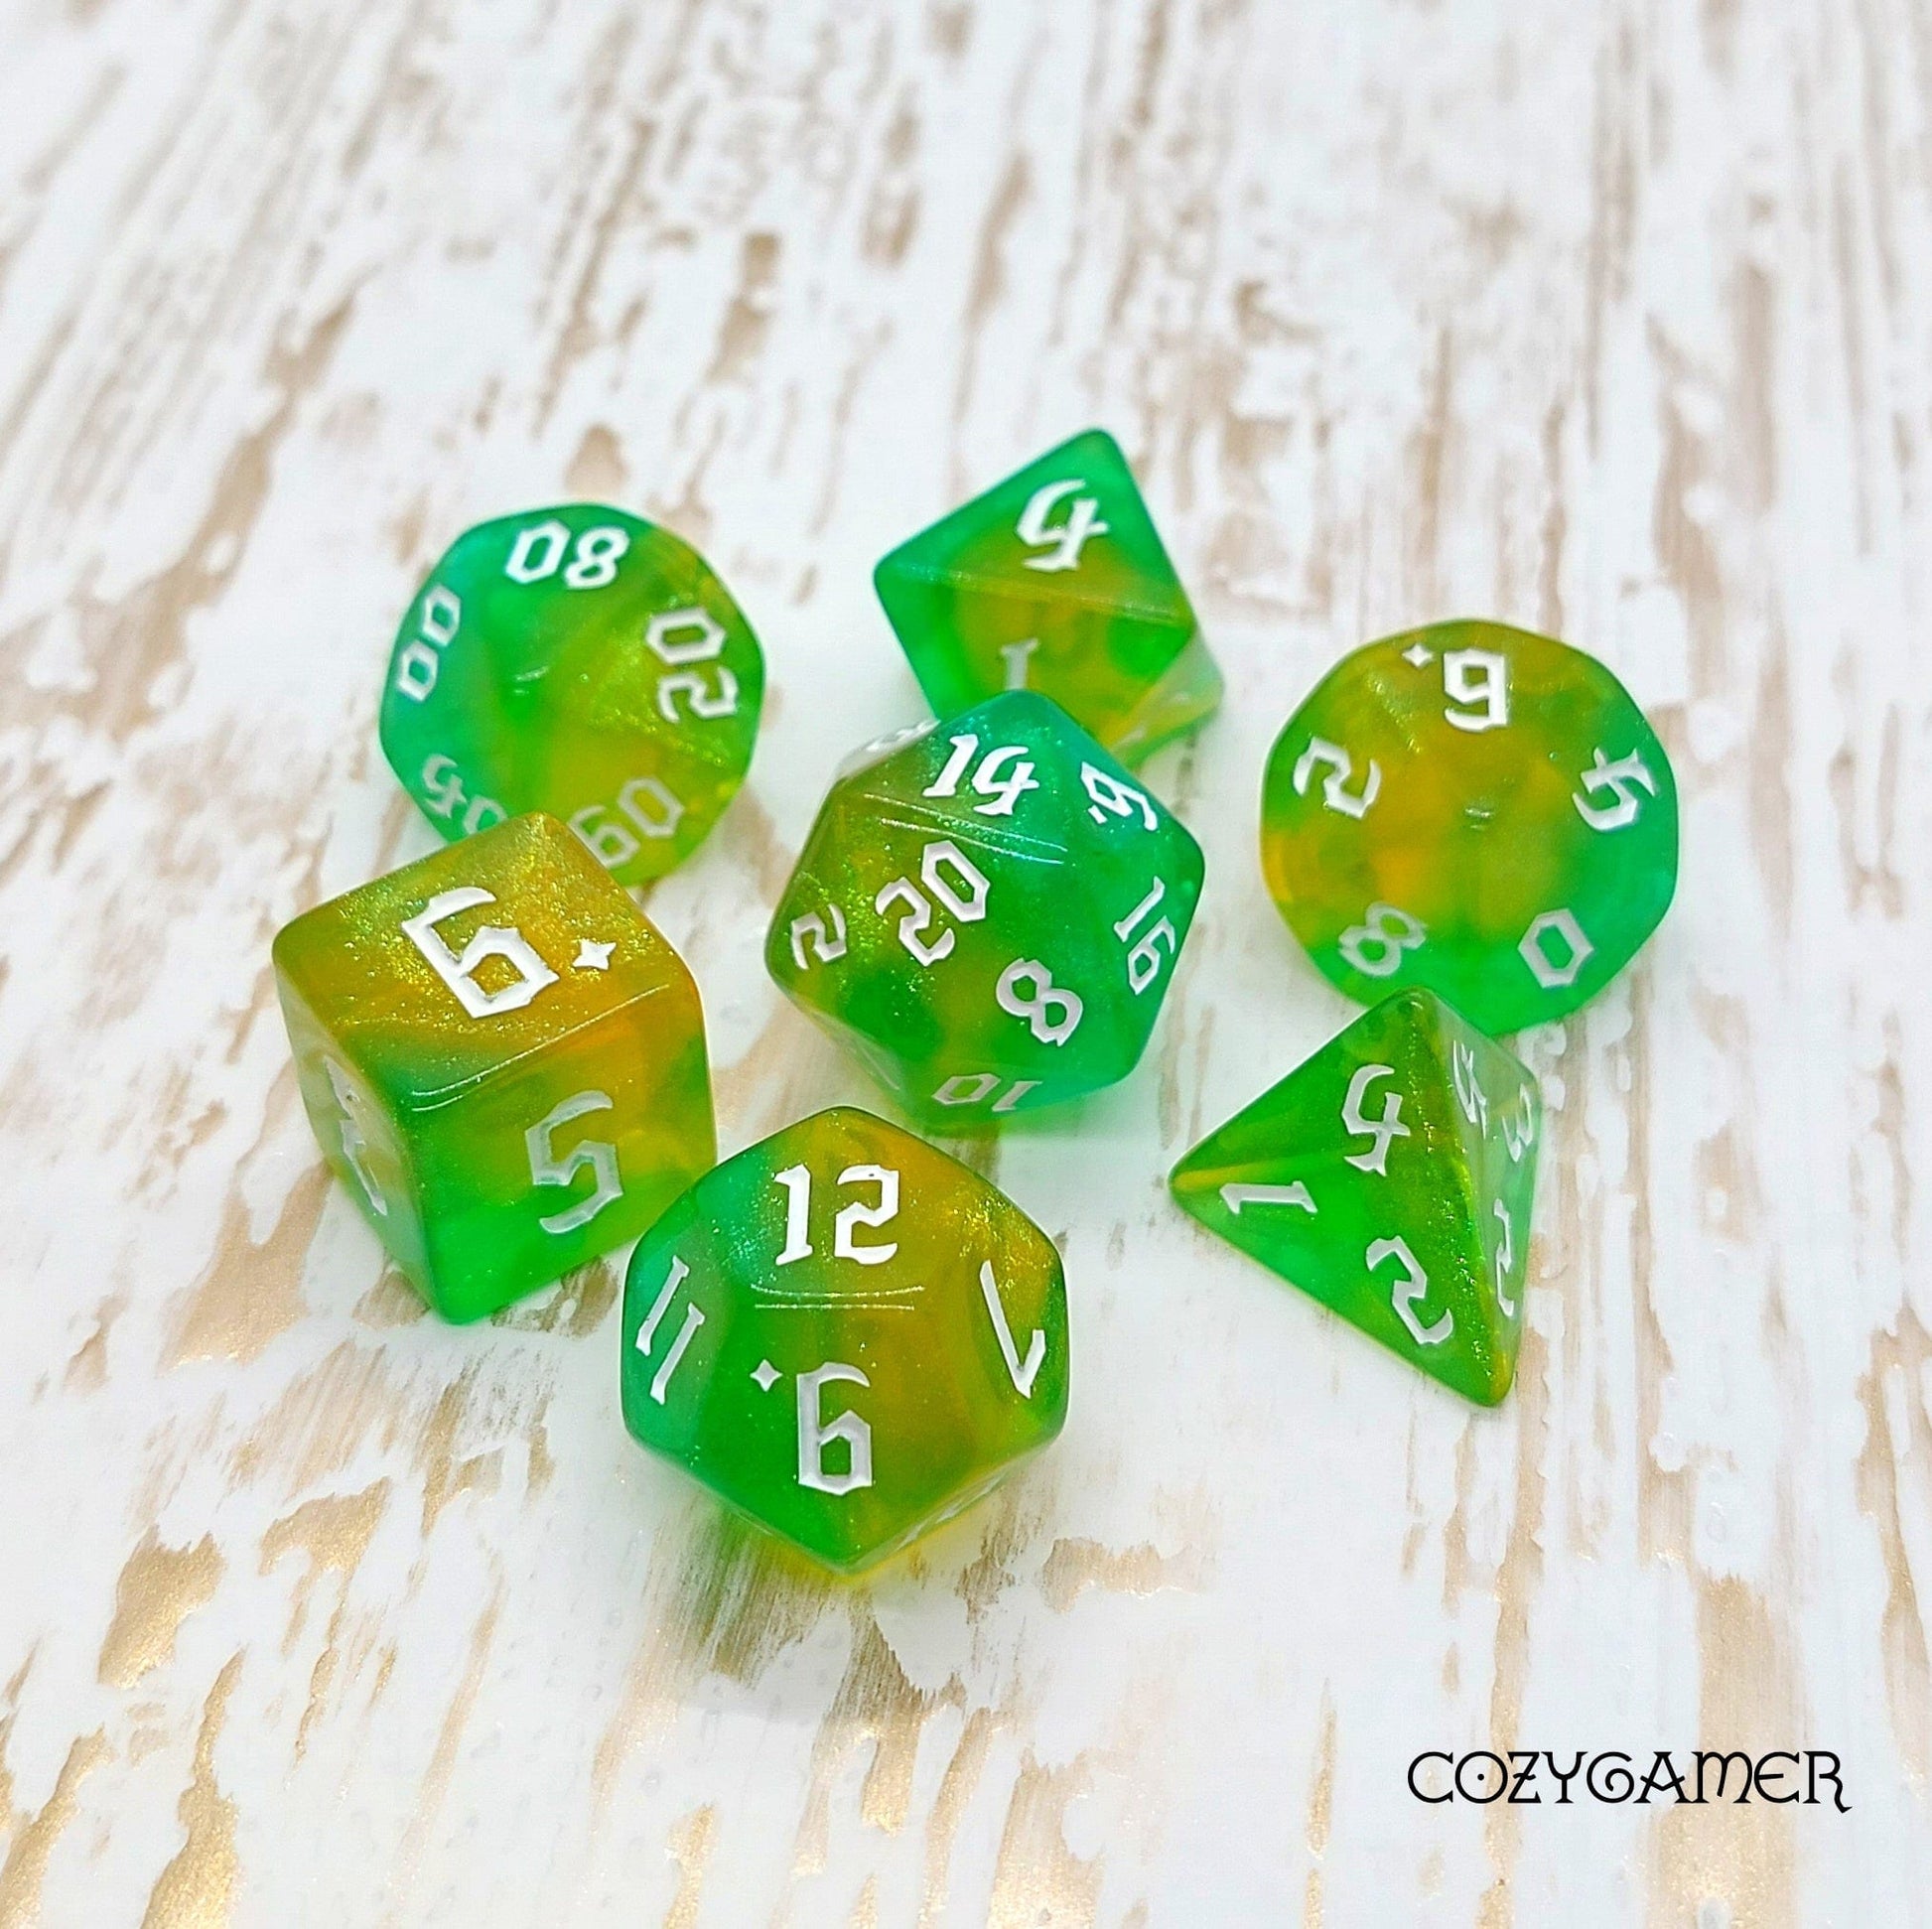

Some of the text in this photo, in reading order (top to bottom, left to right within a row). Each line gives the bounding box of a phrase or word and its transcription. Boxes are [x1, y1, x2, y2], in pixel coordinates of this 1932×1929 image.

[1017, 479, 1110, 572] 4
[398, 583, 462, 703] 00
[645, 607, 738, 724] 20
[922, 734, 1039, 815] 14
[1293, 737, 1381, 820] 2
[1572, 748, 1655, 832] 4
[790, 903, 847, 971] 2
[875, 840, 991, 966] 20
[1113, 876, 1175, 995] 16
[1338, 901, 1427, 977] 8
[1517, 907, 1594, 989] 0
[401, 886, 561, 1020] 6
[995, 957, 1084, 1047] 8
[930, 1073, 1043, 1112] 10
[1341, 1063, 1411, 1176] 4
[524, 1090, 624, 1234] 5
[1219, 1180, 1317, 1214] 1
[773, 1164, 899, 1266] 12
[1365, 1235, 1453, 1345] 2
